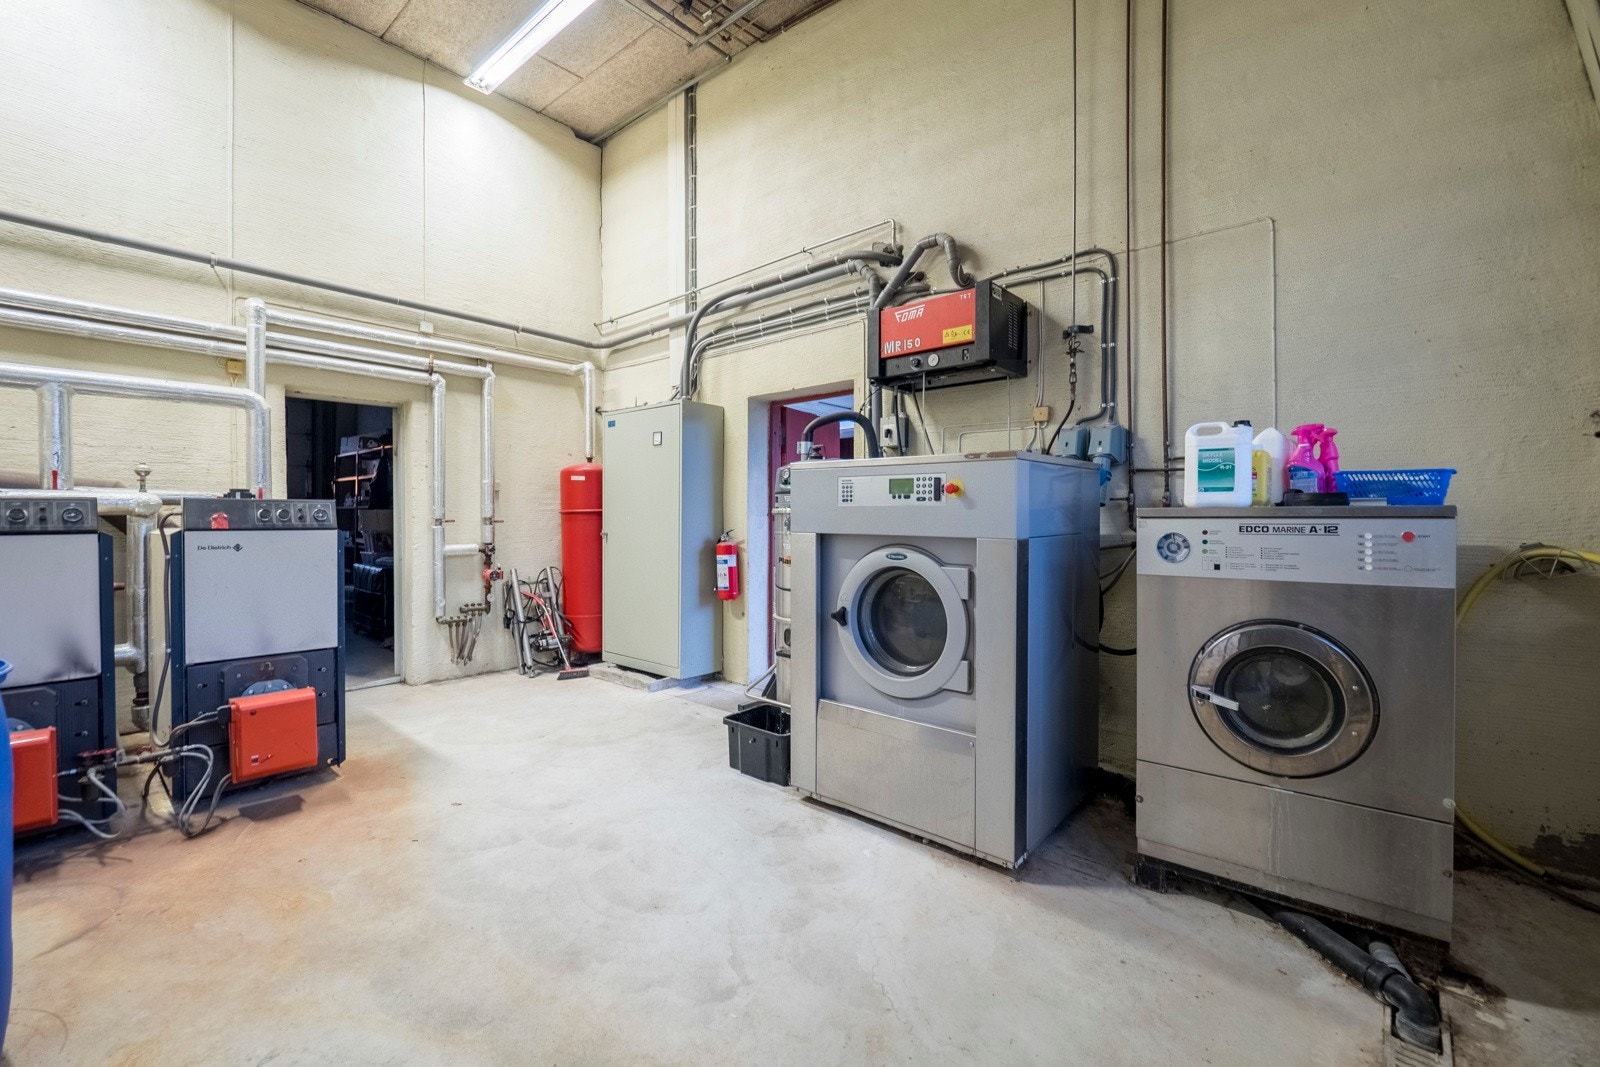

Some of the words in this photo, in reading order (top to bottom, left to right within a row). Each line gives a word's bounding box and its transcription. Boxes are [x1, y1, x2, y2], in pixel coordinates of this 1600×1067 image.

[895, 304, 925, 322] FOMA
[903, 337, 921, 351] 150
[1238, 525, 1270, 533] EDCO
